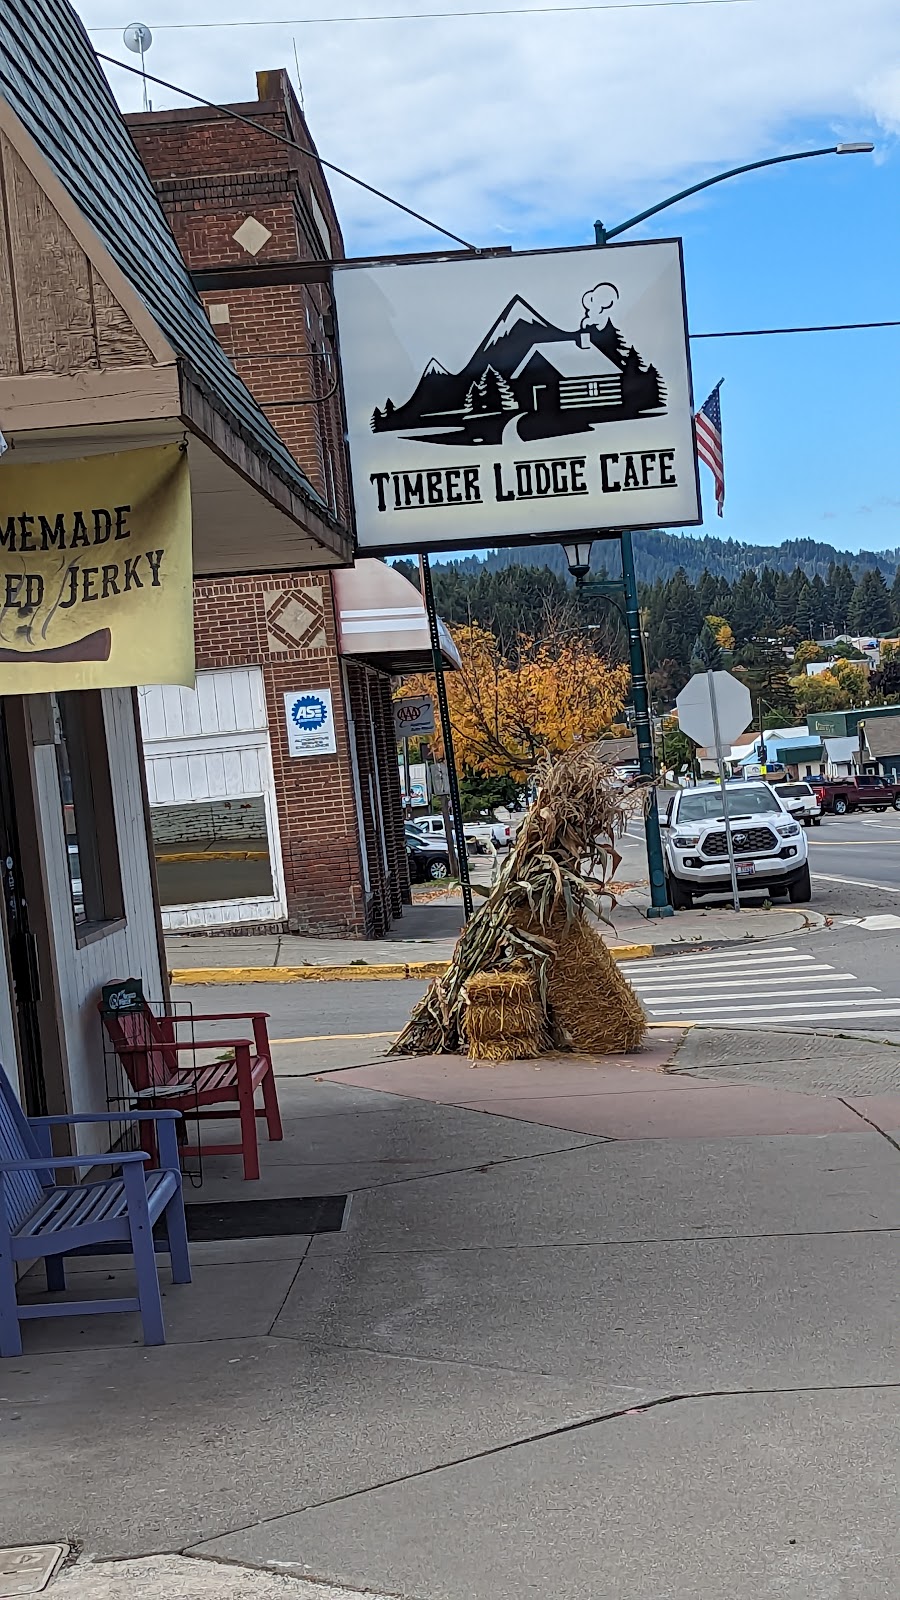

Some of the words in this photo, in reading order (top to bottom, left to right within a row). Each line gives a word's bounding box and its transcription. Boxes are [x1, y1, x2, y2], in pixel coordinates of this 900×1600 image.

[370, 467, 482, 512] TIMBER
[493, 458, 588, 502] LODGE
[599, 451, 677, 493] CAFE
[0, 574, 45, 608] ED
[58, 549, 165, 609] JERKY
[295, 704, 322, 720] ASE
[399, 706, 420, 721] AAA
